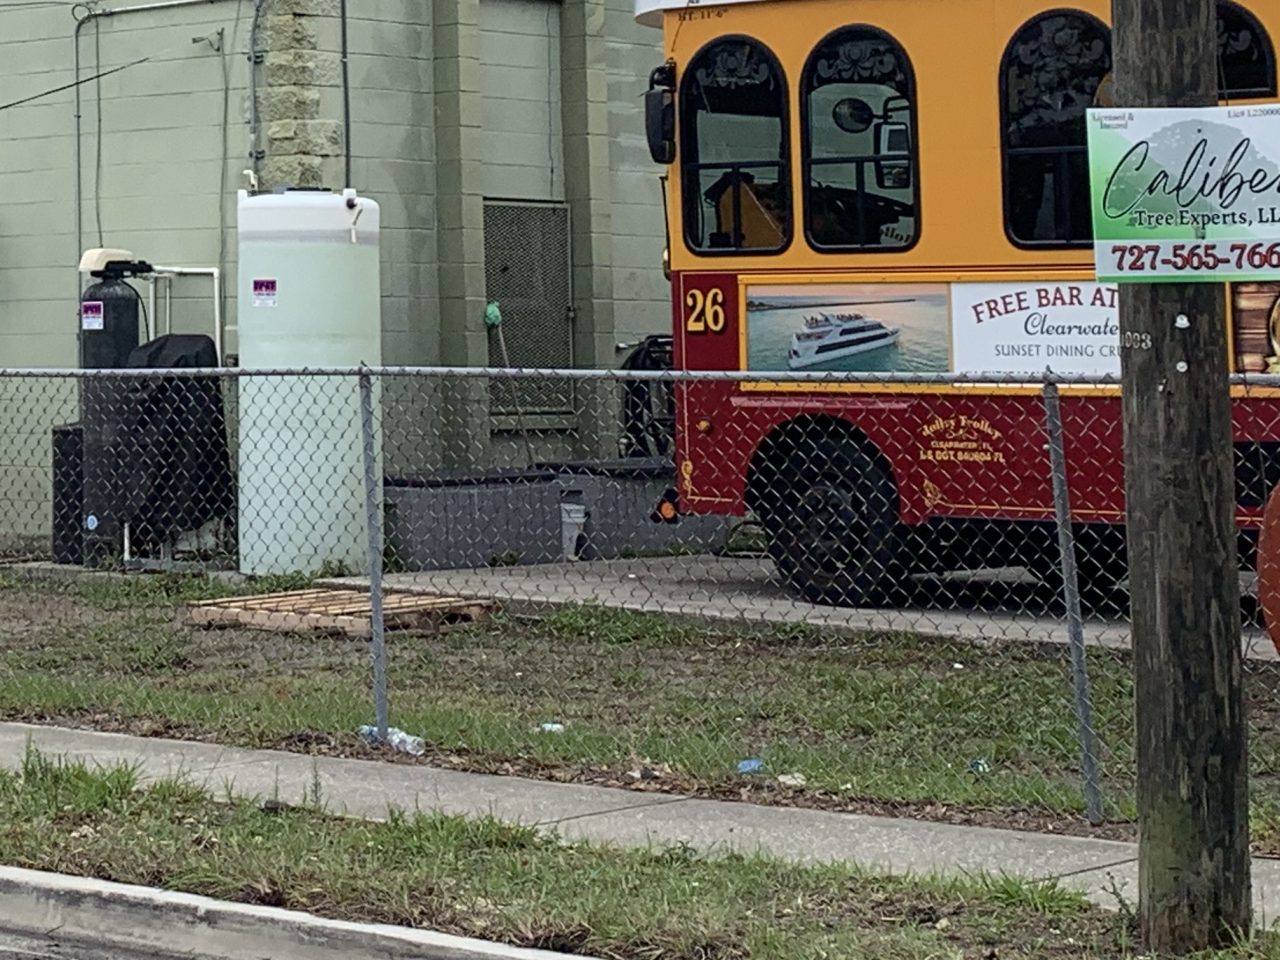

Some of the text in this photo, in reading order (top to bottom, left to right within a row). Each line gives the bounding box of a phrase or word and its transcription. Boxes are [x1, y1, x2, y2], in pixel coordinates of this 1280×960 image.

[1134, 210, 1174, 226] Tree
[1179, 210, 1253, 230] Experts,
[686, 288, 725, 332] 26
[971, 291, 1030, 324] FREE
[1036, 286, 1084, 308] BAR
[1024, 312, 1120, 336] Clearwate
[994, 343, 1041, 357] SUNSET
[1046, 344, 1094, 358] DINING
